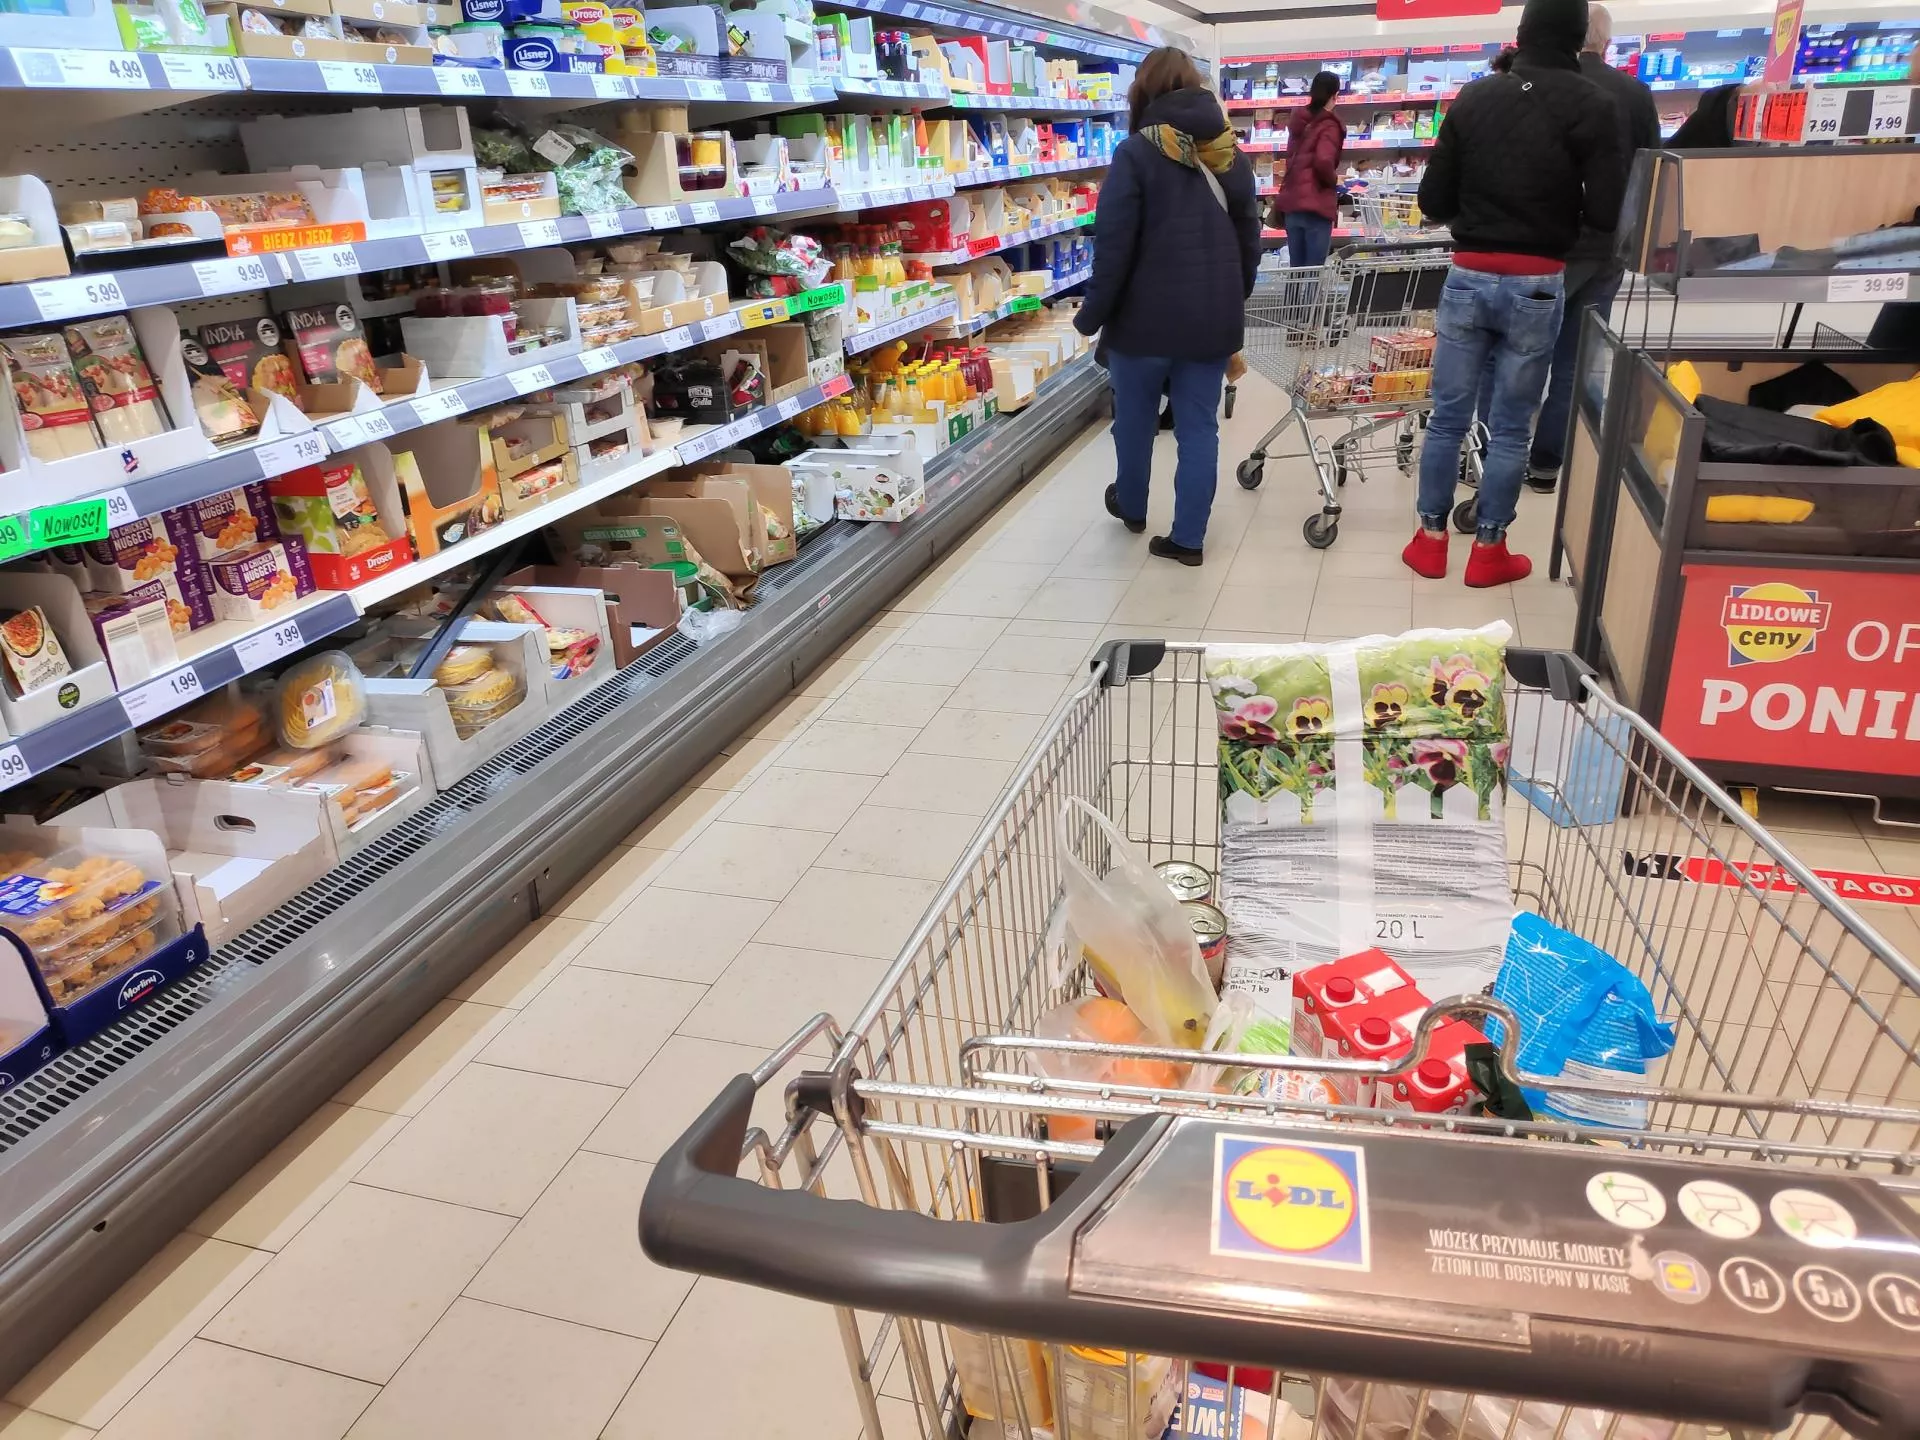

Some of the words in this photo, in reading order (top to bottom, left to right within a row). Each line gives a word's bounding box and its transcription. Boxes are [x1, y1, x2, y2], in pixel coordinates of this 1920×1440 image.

[470, 0, 498, 10] Lisner
[613, 14, 636, 25] rosed
[518, 50, 549, 61] Lisner
[569, 57, 597, 74] Lisner
[109, 60, 143, 79] 4.99
[204, 62, 237, 80] 3.49
[354, 68, 378, 84] 5.99
[462, 74, 482, 88] 6.99
[1809, 119, 1838, 133] 7.99
[1874, 116, 1903, 131] 7.99
[262, 232, 296, 251] BIERZ
[306, 229, 333, 246] JEDZ
[333, 251, 357, 268] 9.99
[238, 263, 265, 282] 9.99
[86, 282, 120, 304] 5.99
[1864, 277, 1905, 293] 39.99
[205, 324, 246, 346] INDIA
[365, 418, 389, 434] 9.99
[294, 439, 320, 459] 7.99
[109, 496, 128, 516] .99
[200, 502, 236, 520] NUGGETS
[43, 506, 103, 538] Nowość!
[120, 518, 150, 537] CHICKEN
[113, 528, 153, 551] NUGGETS
[243, 560, 278, 584] NUGGETS
[1729, 602, 1822, 624] LIDLOWE
[275, 625, 300, 647] 3.99
[1738, 629, 1803, 650] ceny
[171, 672, 198, 695] 1.99
[1699, 678, 1920, 742] PONI
[2, 754, 25, 779] .99
[1747, 869, 1865, 895] OFETA
[1870, 881, 1914, 898] OD
[1376, 919, 1403, 939] 20
[1413, 920, 1425, 939] L
[123, 974, 157, 1001] Morliny
[1258, 985, 1270, 994] kg
[1429, 1227, 1479, 1252] WÓZEK
[1482, 1233, 1562, 1260] PRZYJMUJE
[1563, 1242, 1626, 1268] MONETY
[1474, 1261, 1502, 1281] LIDL
[1504, 1263, 1573, 1288] DOSTĘPNY
[1574, 1271, 1591, 1290] W
[1592, 1273, 1632, 1295] KASIE
